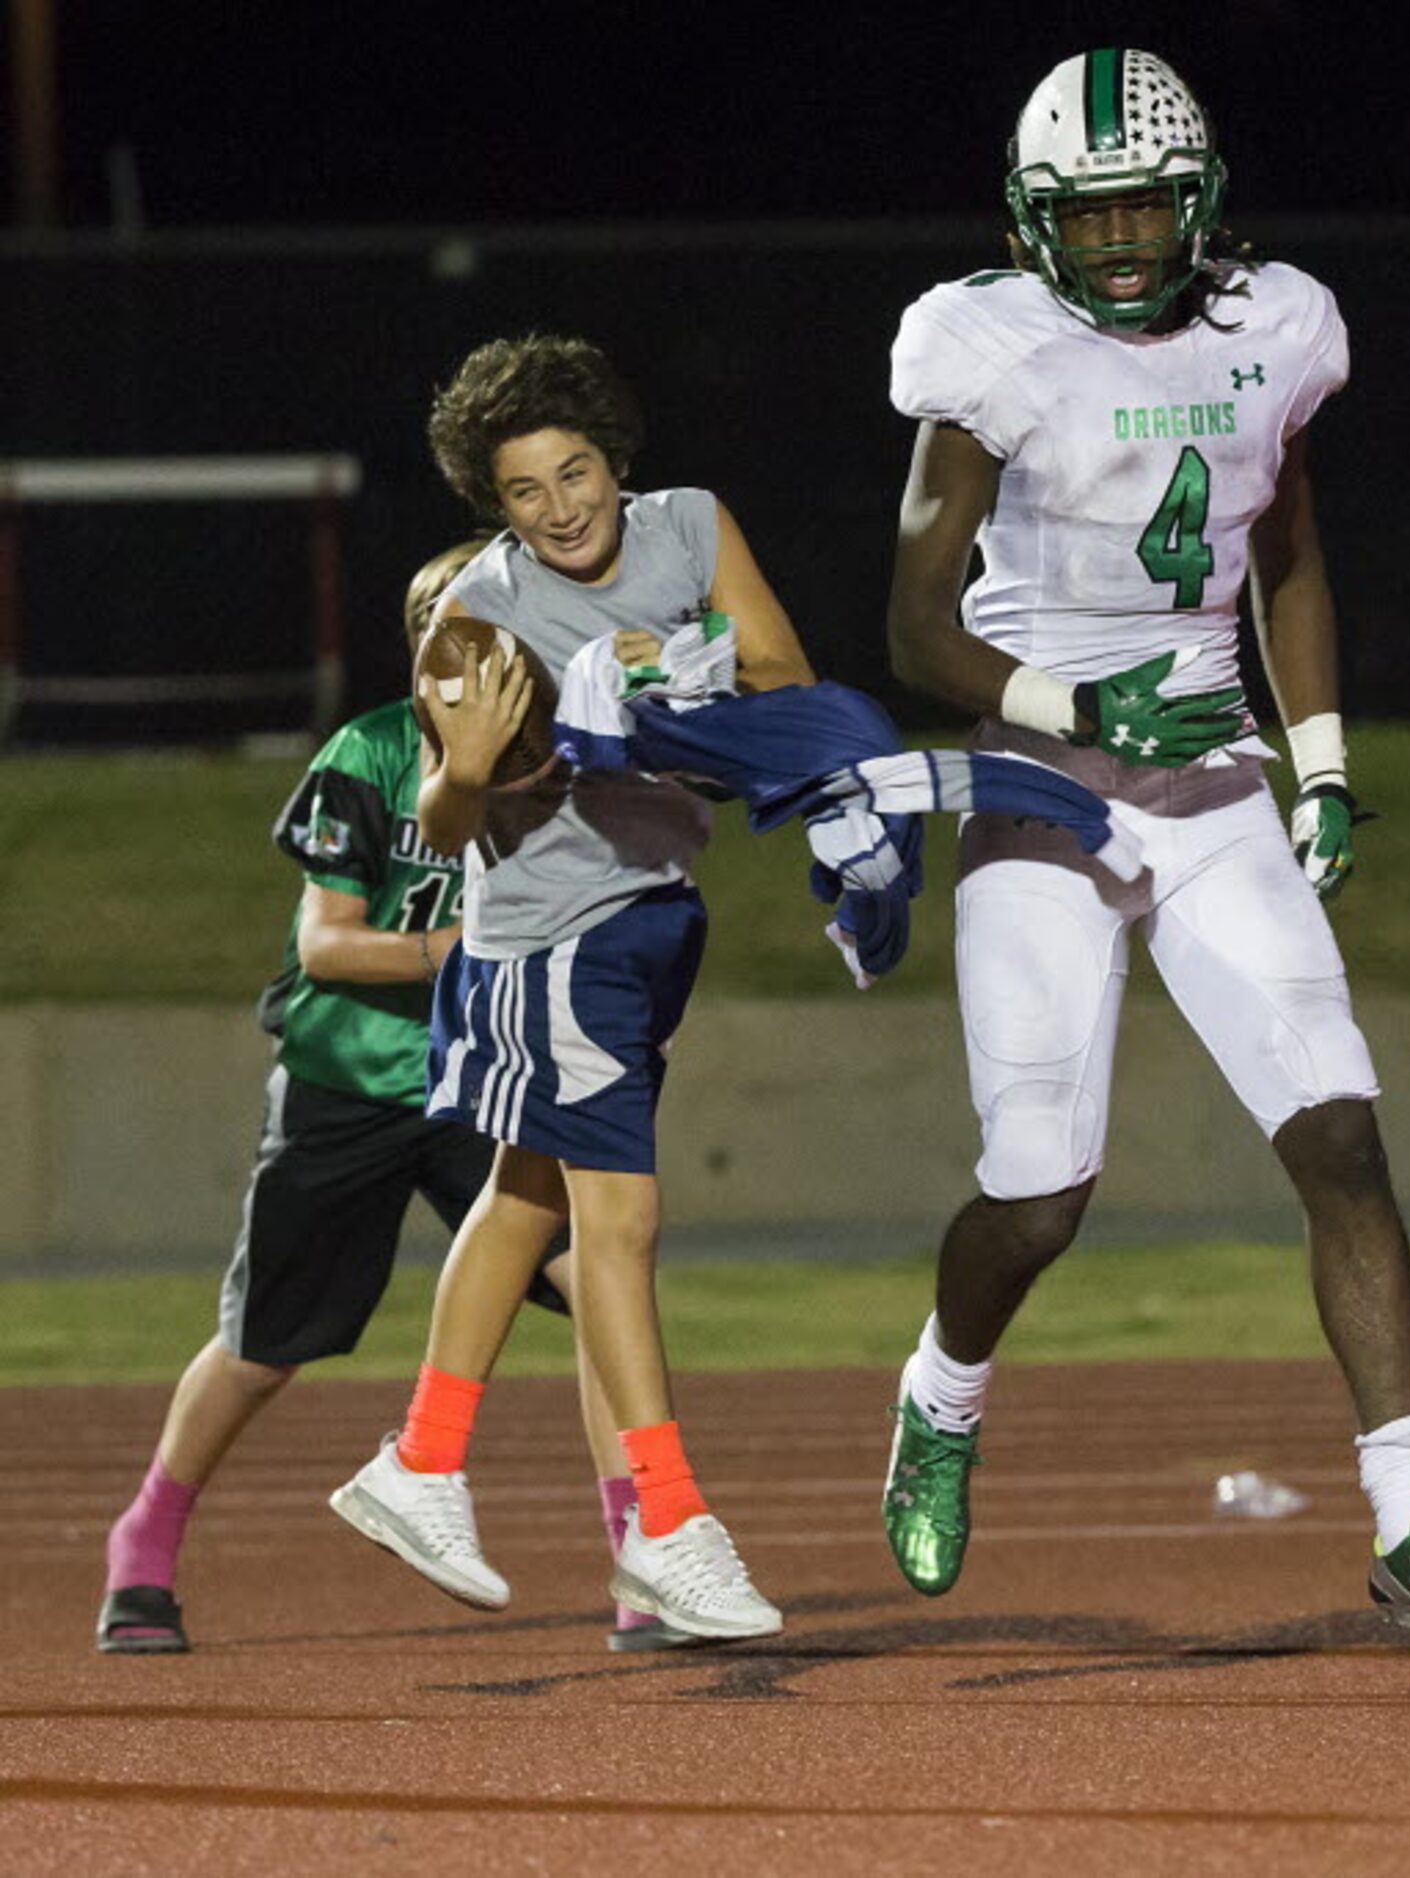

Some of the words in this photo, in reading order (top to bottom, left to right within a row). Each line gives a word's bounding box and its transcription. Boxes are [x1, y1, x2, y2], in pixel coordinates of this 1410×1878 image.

[1114, 402, 1236, 440] DRAGONS
[1135, 445, 1214, 609] 4
[399, 872, 464, 932] 1
